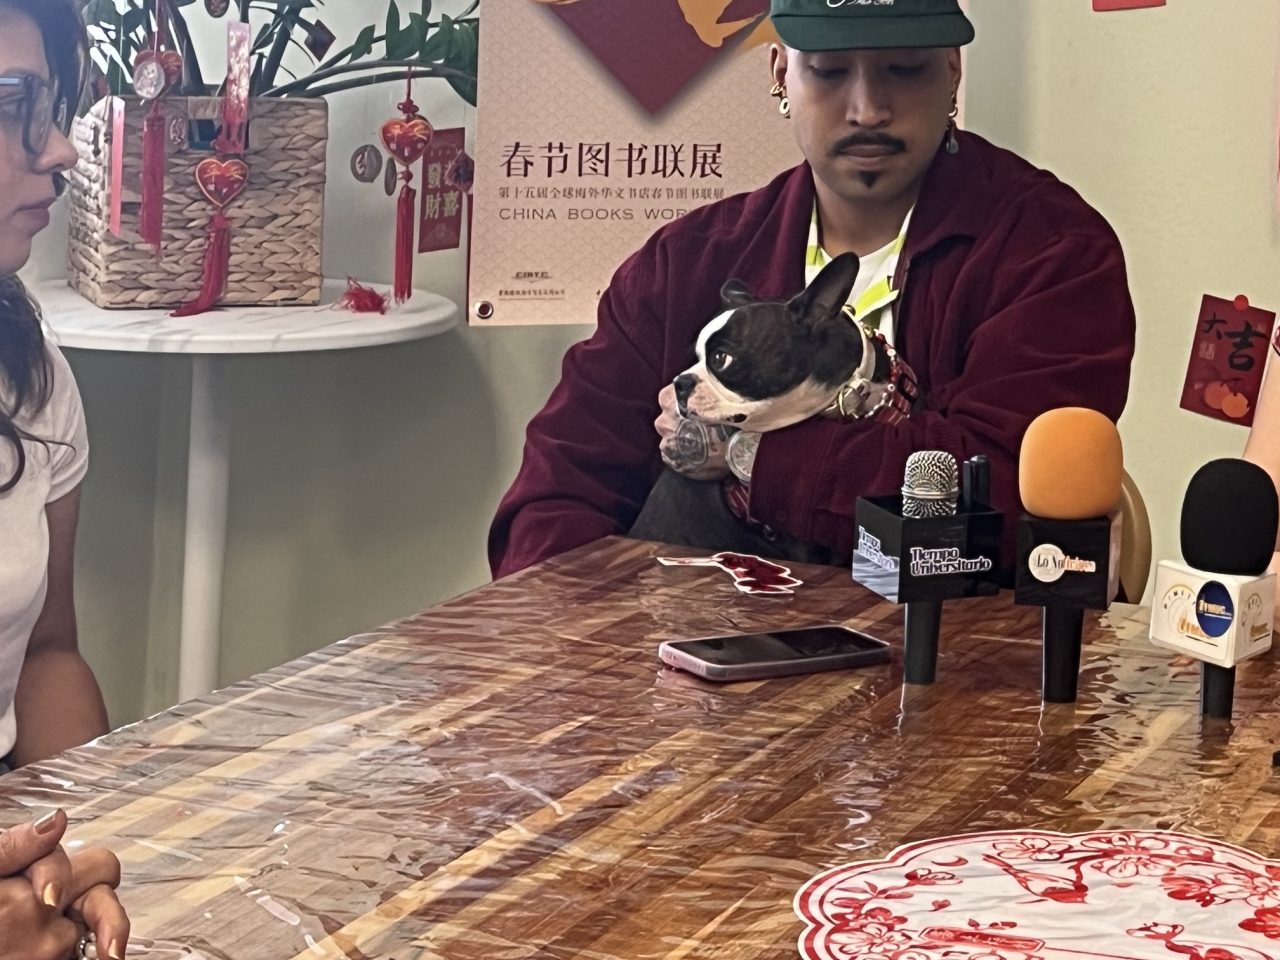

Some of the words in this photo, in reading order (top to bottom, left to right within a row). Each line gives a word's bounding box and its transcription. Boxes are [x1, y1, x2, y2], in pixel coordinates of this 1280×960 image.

[500, 141, 723, 178] 春节图书联展
[499, 208, 557, 220] CHINA
[568, 208, 634, 220] BOOKS
[644, 208, 689, 220] WOR
[910, 547, 960, 563] Tiempo
[910, 556, 992, 576] Universitario
